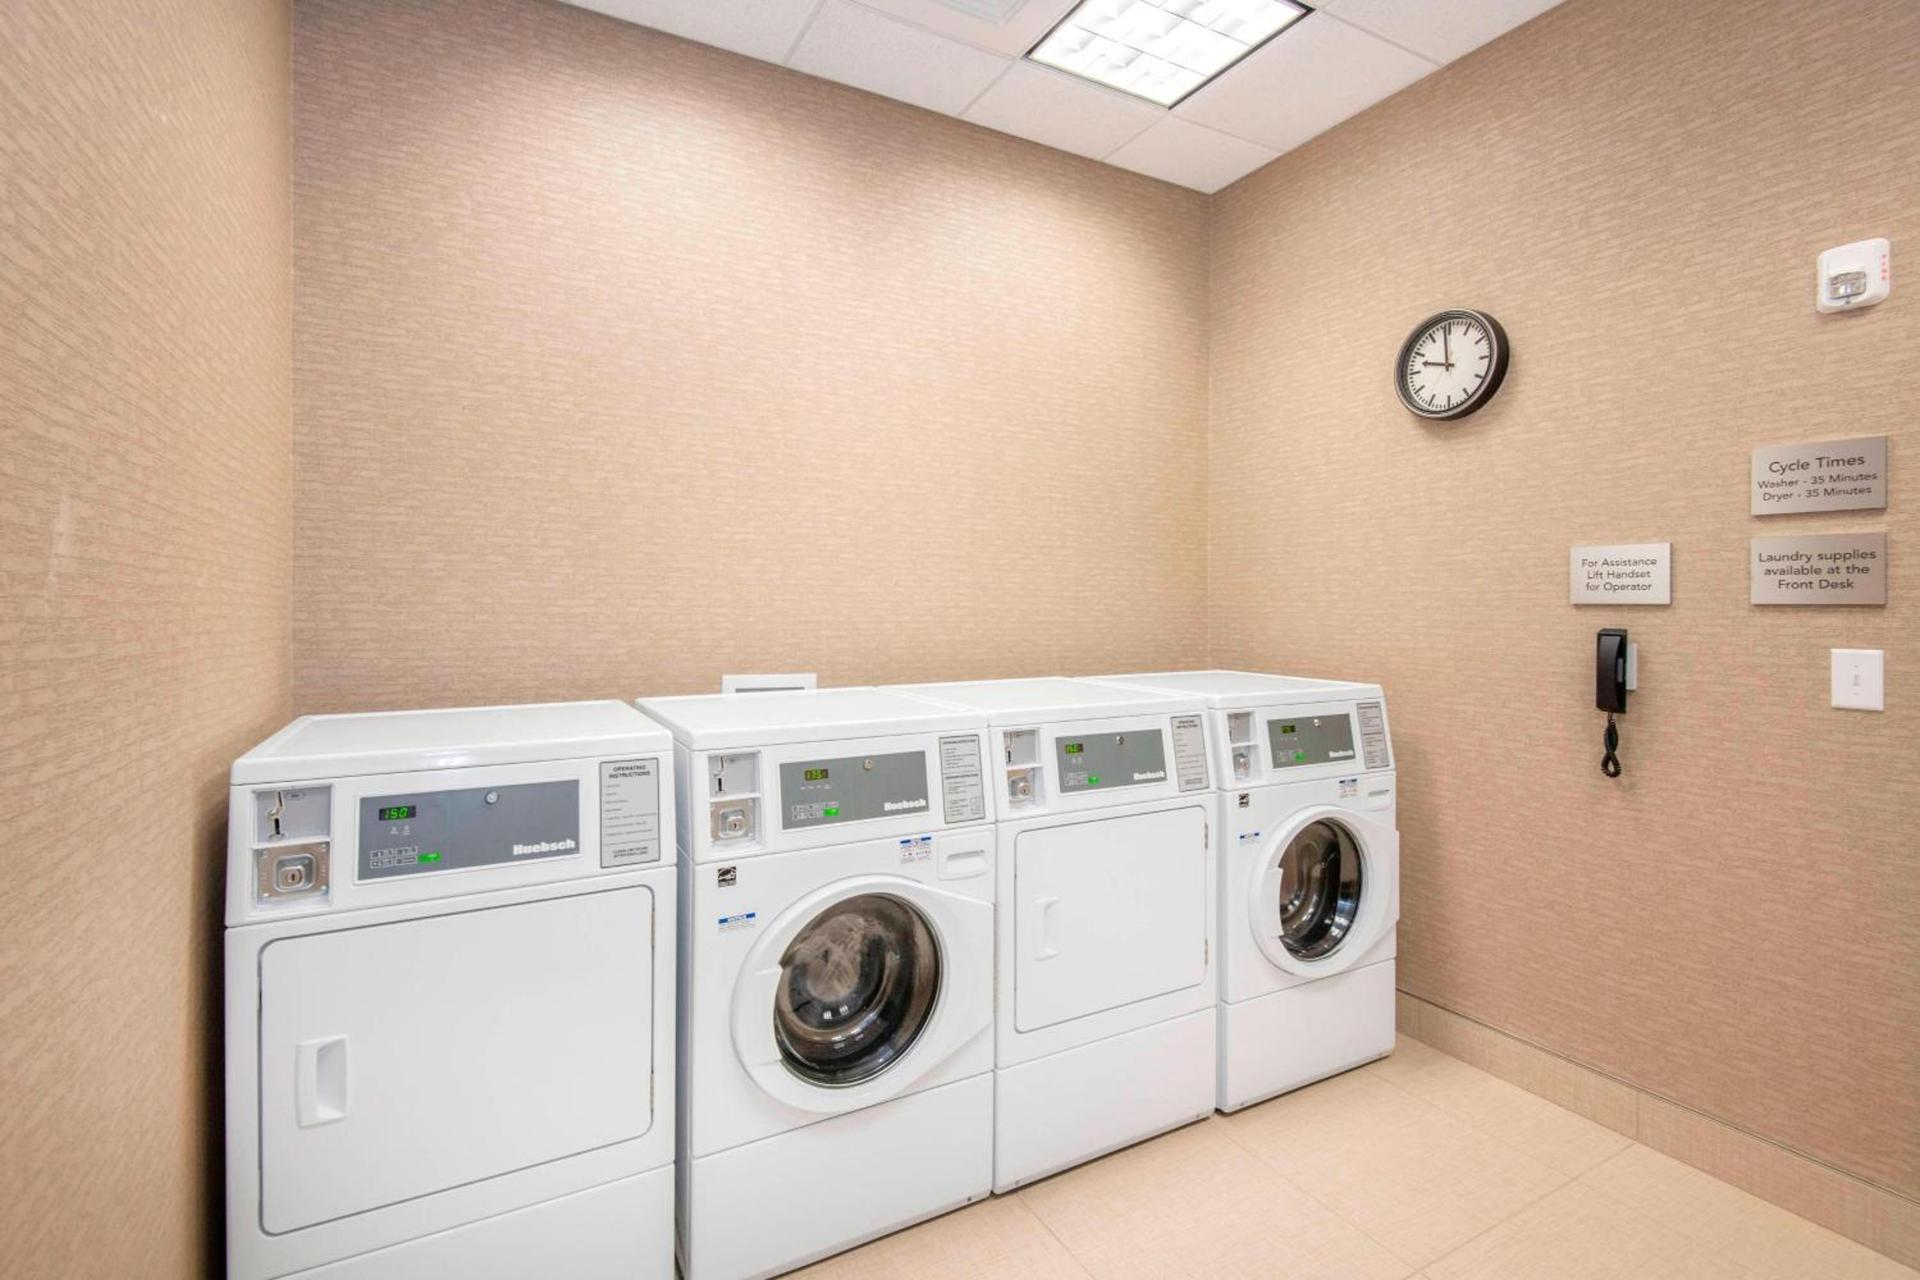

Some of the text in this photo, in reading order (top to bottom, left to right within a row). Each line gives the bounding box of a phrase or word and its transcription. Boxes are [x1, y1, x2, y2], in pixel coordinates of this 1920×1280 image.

[1768, 456, 1866, 476] Cycle Times
[1757, 477, 1800, 489] Washer
[1810, 475, 1825, 485] 35
[1828, 472, 1879, 483] Minutes
[1762, 491, 1794, 502] Dryer
[1805, 488, 1820, 498] 35
[1823, 486, 1873, 497] Minutes
[1758, 548, 1877, 563] Laundry supplies
[1581, 558, 1658, 568] For Assistance
[1586, 569, 1652, 579] Lift Handset
[1763, 564, 1870, 576] available at the
[1585, 581, 1652, 593] for Operator
[1777, 578, 1855, 590] Front Desk
[513, 838, 576, 855] Huebsch
